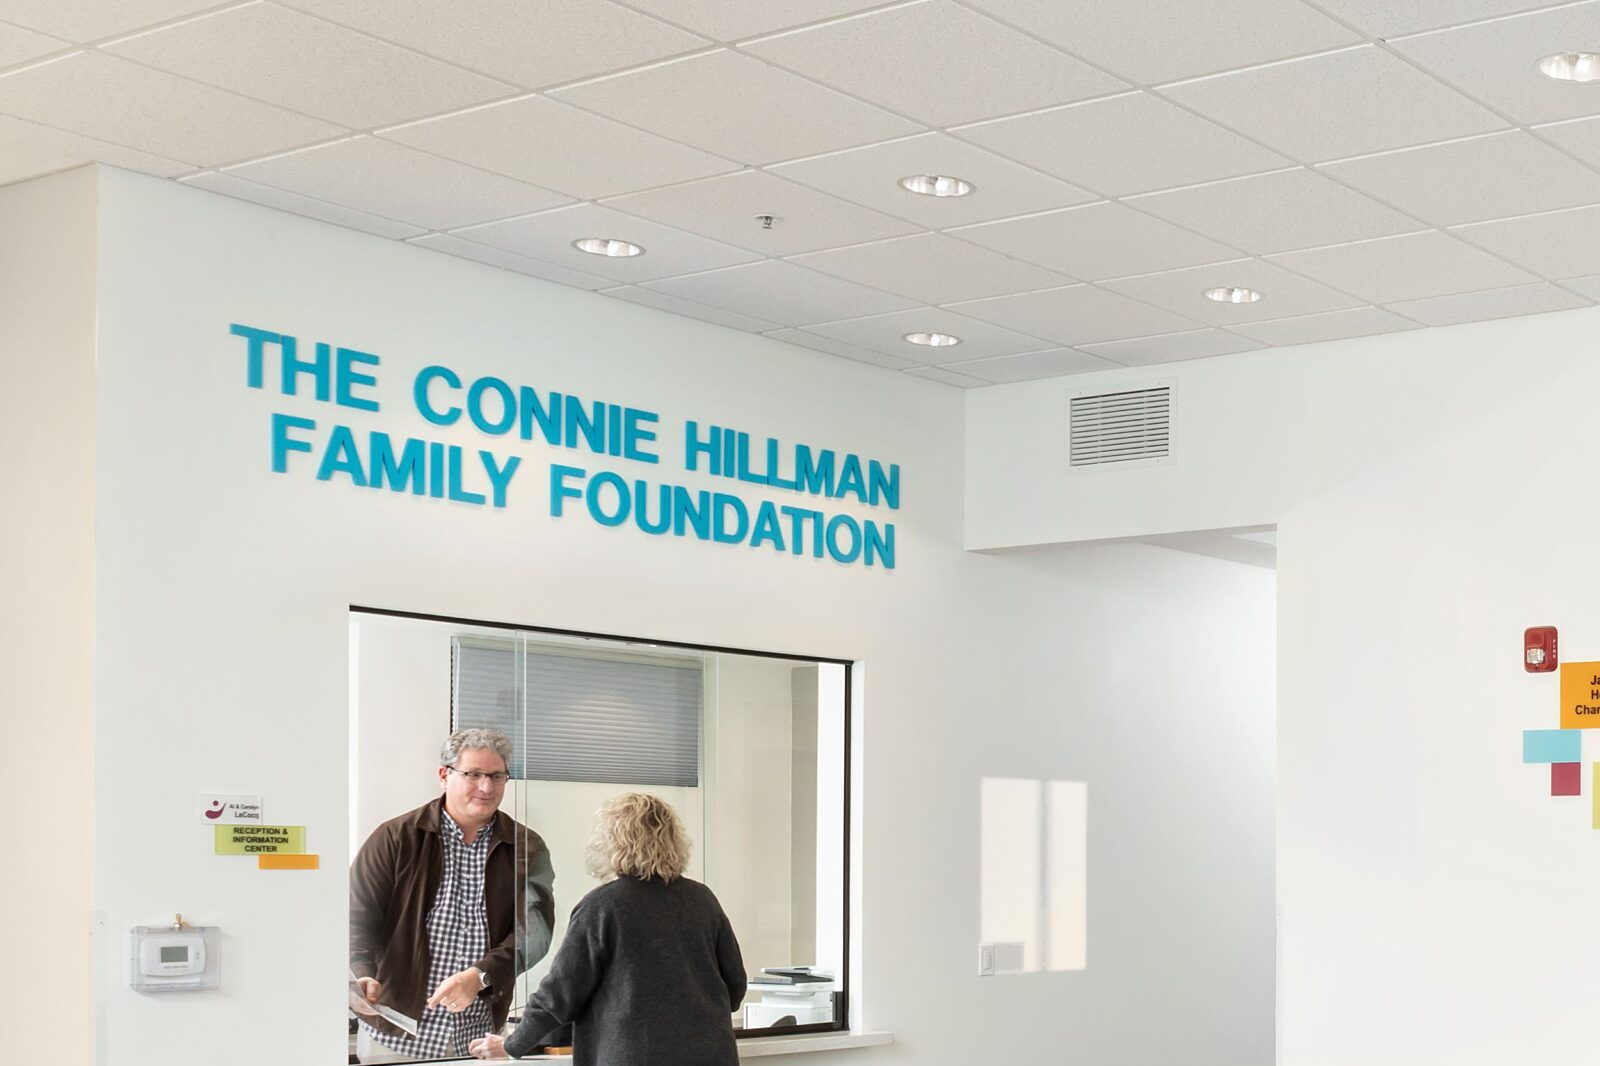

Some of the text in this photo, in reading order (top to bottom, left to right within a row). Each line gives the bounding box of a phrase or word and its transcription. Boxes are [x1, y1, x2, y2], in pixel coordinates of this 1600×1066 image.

[230, 324, 900, 510] THE CONNIE HILLMAN
[272, 412, 896, 569] FAMILY FOUNDATION
